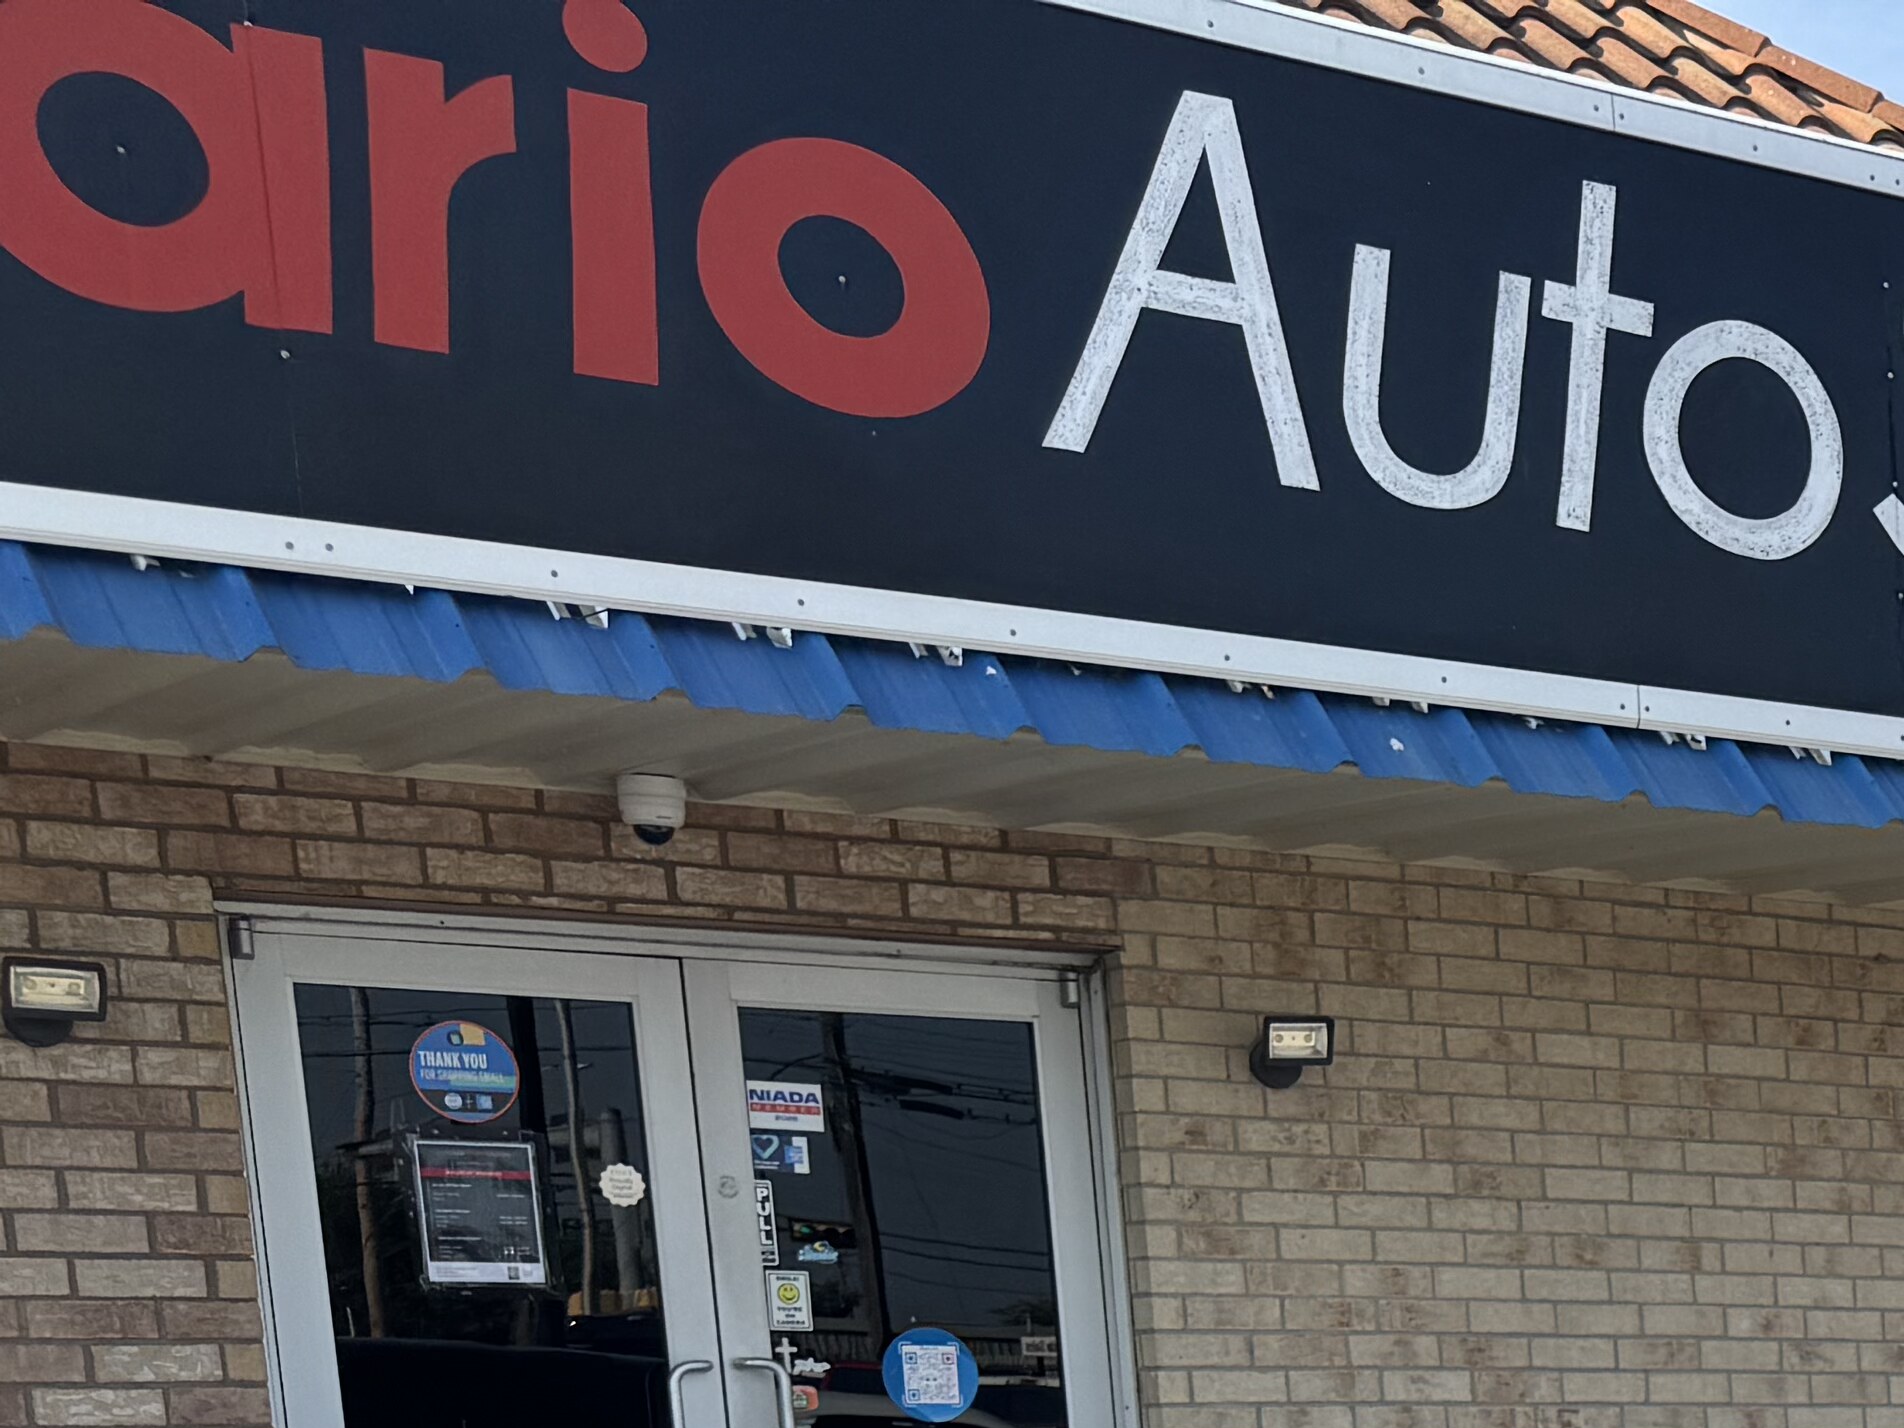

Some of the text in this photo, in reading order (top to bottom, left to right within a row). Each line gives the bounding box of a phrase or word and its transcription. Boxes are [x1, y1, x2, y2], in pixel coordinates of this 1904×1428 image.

[1042, 89, 1844, 561] Auto
[417, 1050, 488, 1070] THANK YOU
[749, 1088, 820, 1105] NIADA
[755, 1187, 773, 1245] PULL
